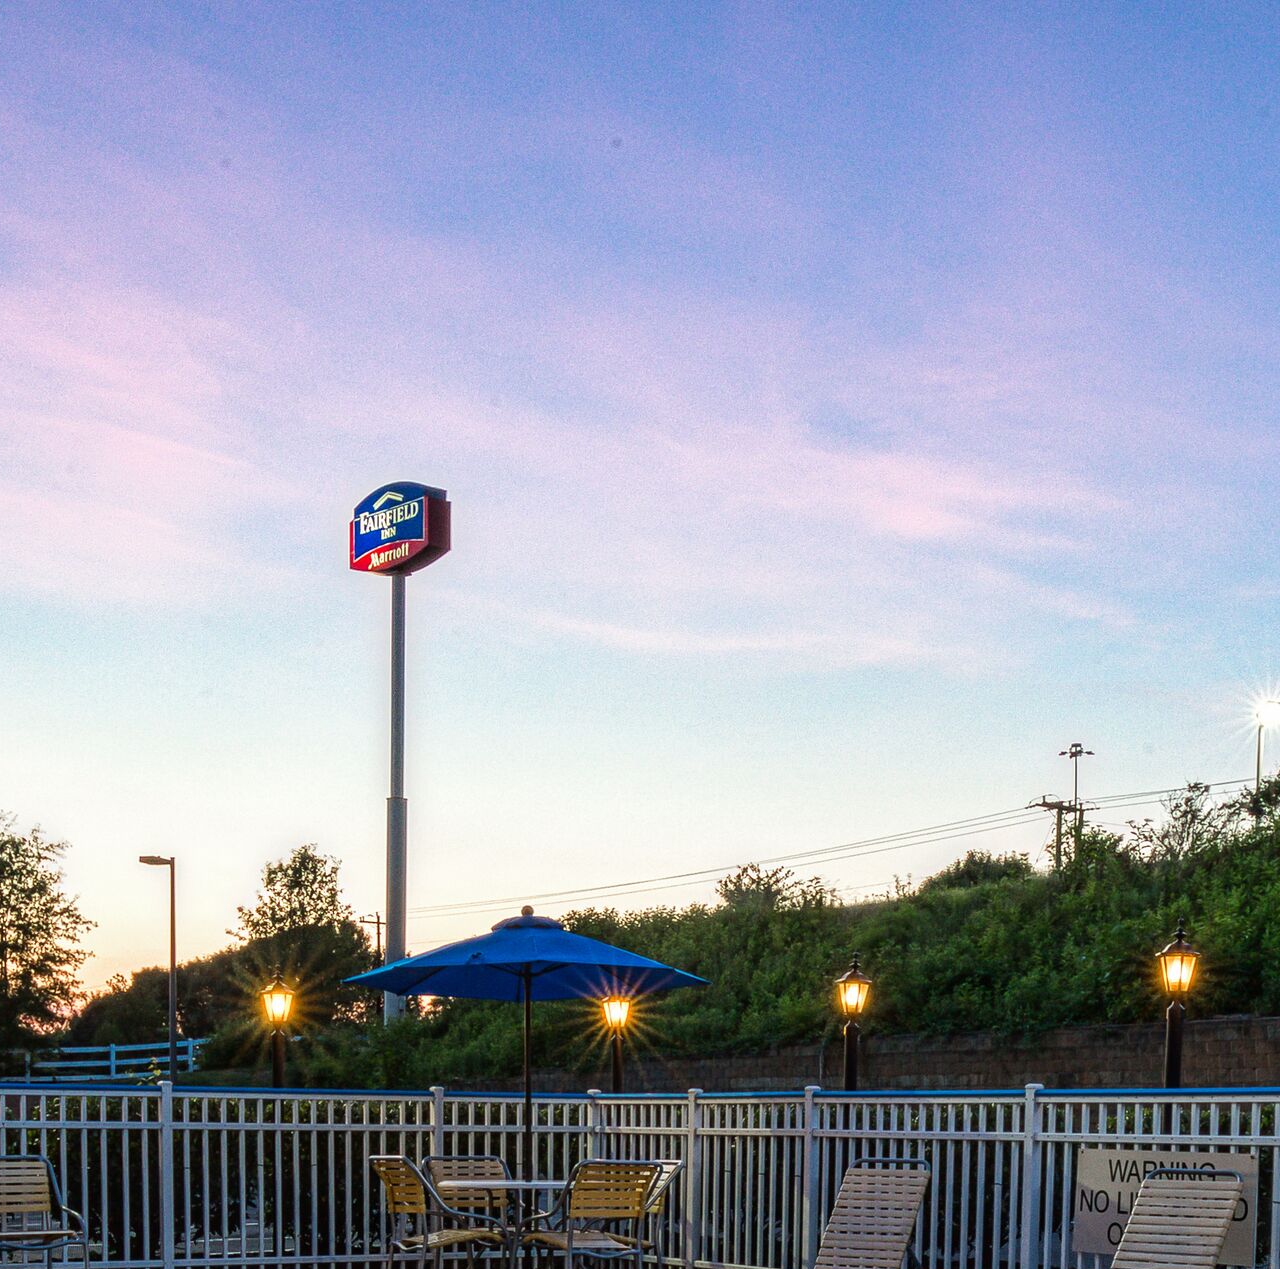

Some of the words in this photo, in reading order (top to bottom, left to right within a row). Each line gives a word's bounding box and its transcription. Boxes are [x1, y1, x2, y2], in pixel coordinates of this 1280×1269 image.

[359, 501, 419, 535] FAIRFIELD
[381, 526, 396, 540] INN
[368, 543, 409, 570] Marriott
[1080, 1189, 1109, 1213] NO
